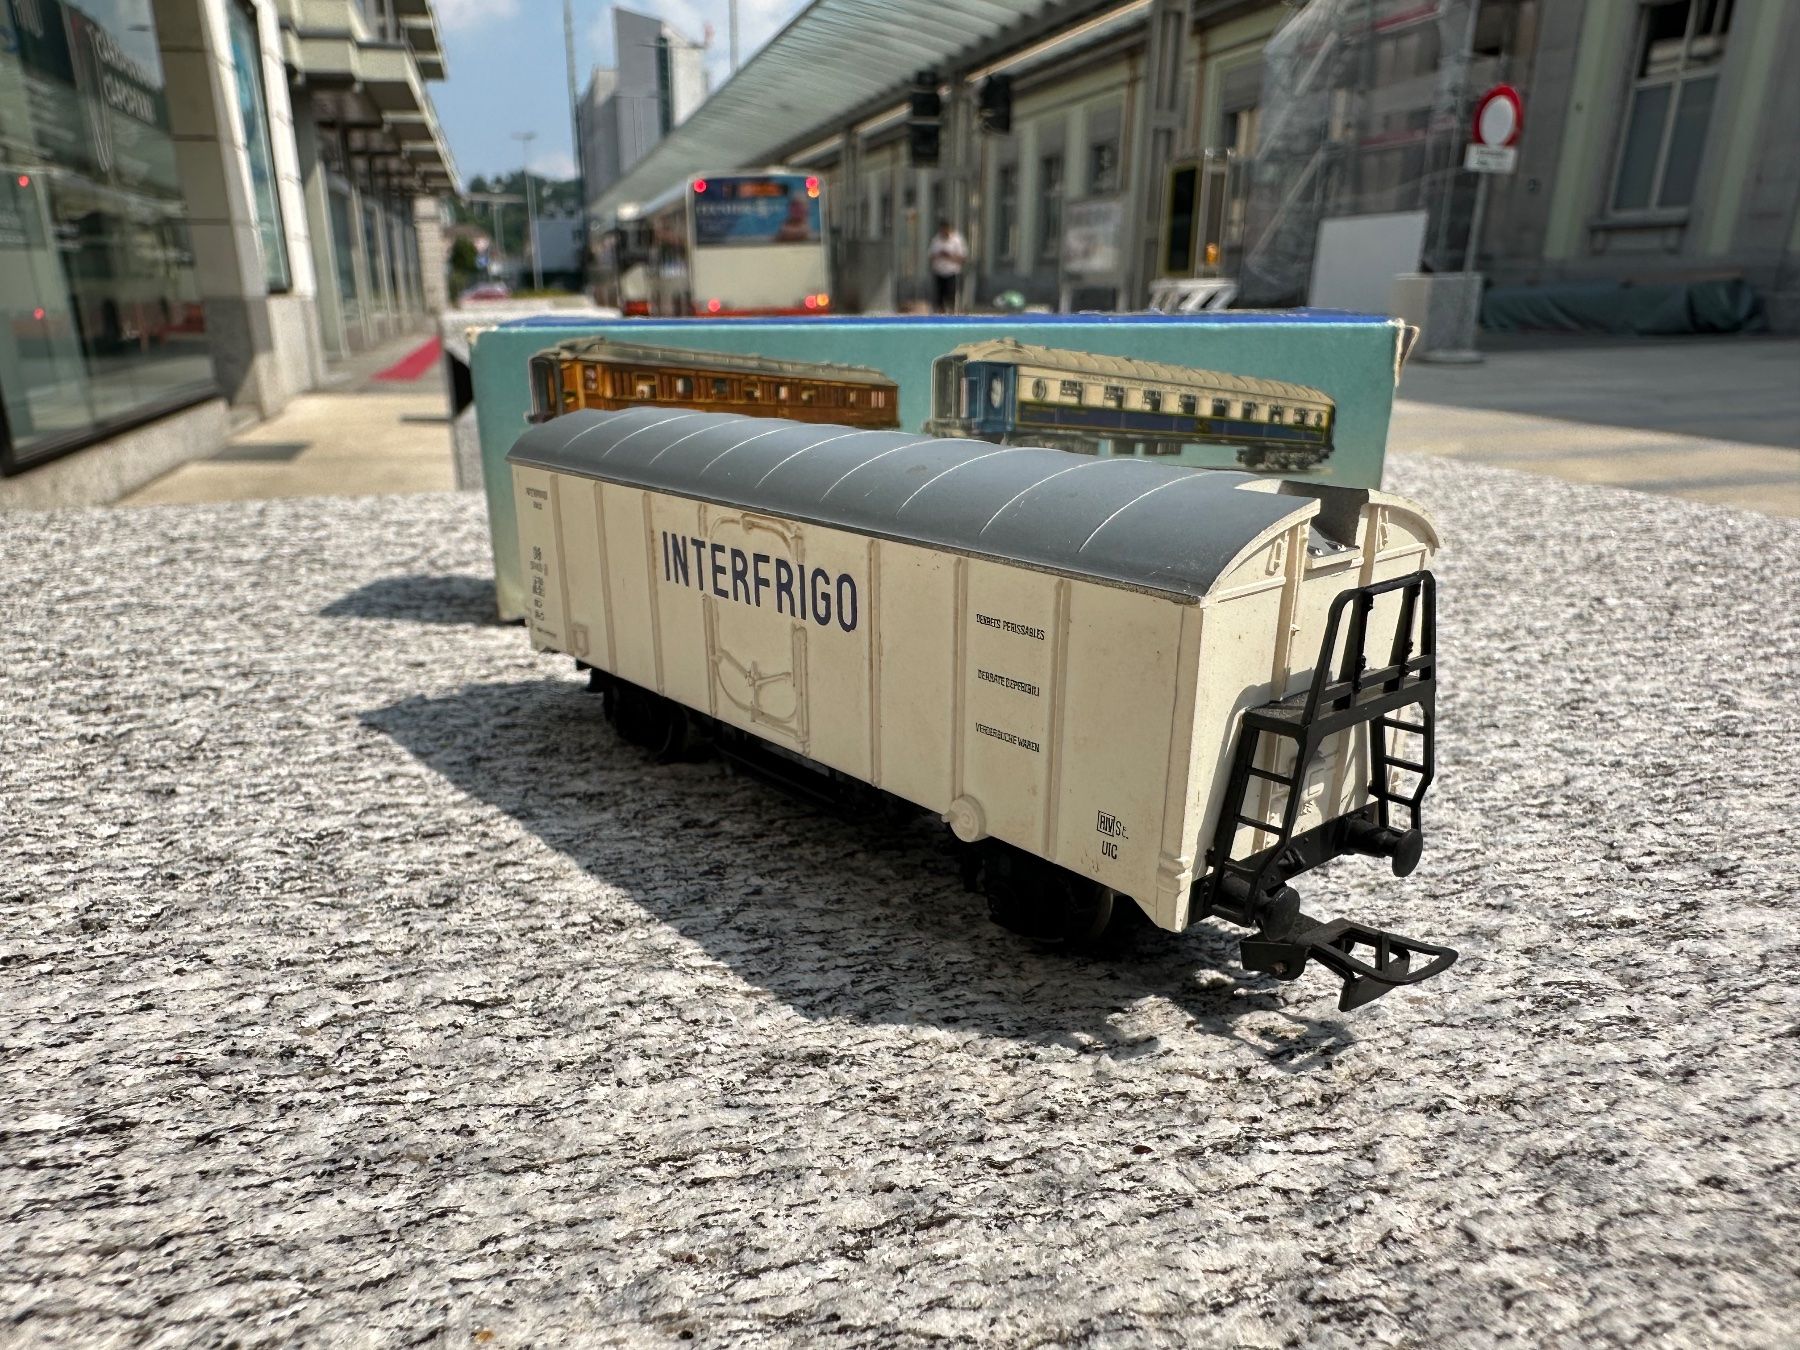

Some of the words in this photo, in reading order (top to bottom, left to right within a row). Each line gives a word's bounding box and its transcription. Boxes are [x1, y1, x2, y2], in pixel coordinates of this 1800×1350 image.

[662, 531, 858, 633] INTERFRIGO
[1003, 620, 1046, 641] PERISSABLES
[1018, 737, 1040, 752] WAREN
[1101, 840, 1118, 860] UIC
